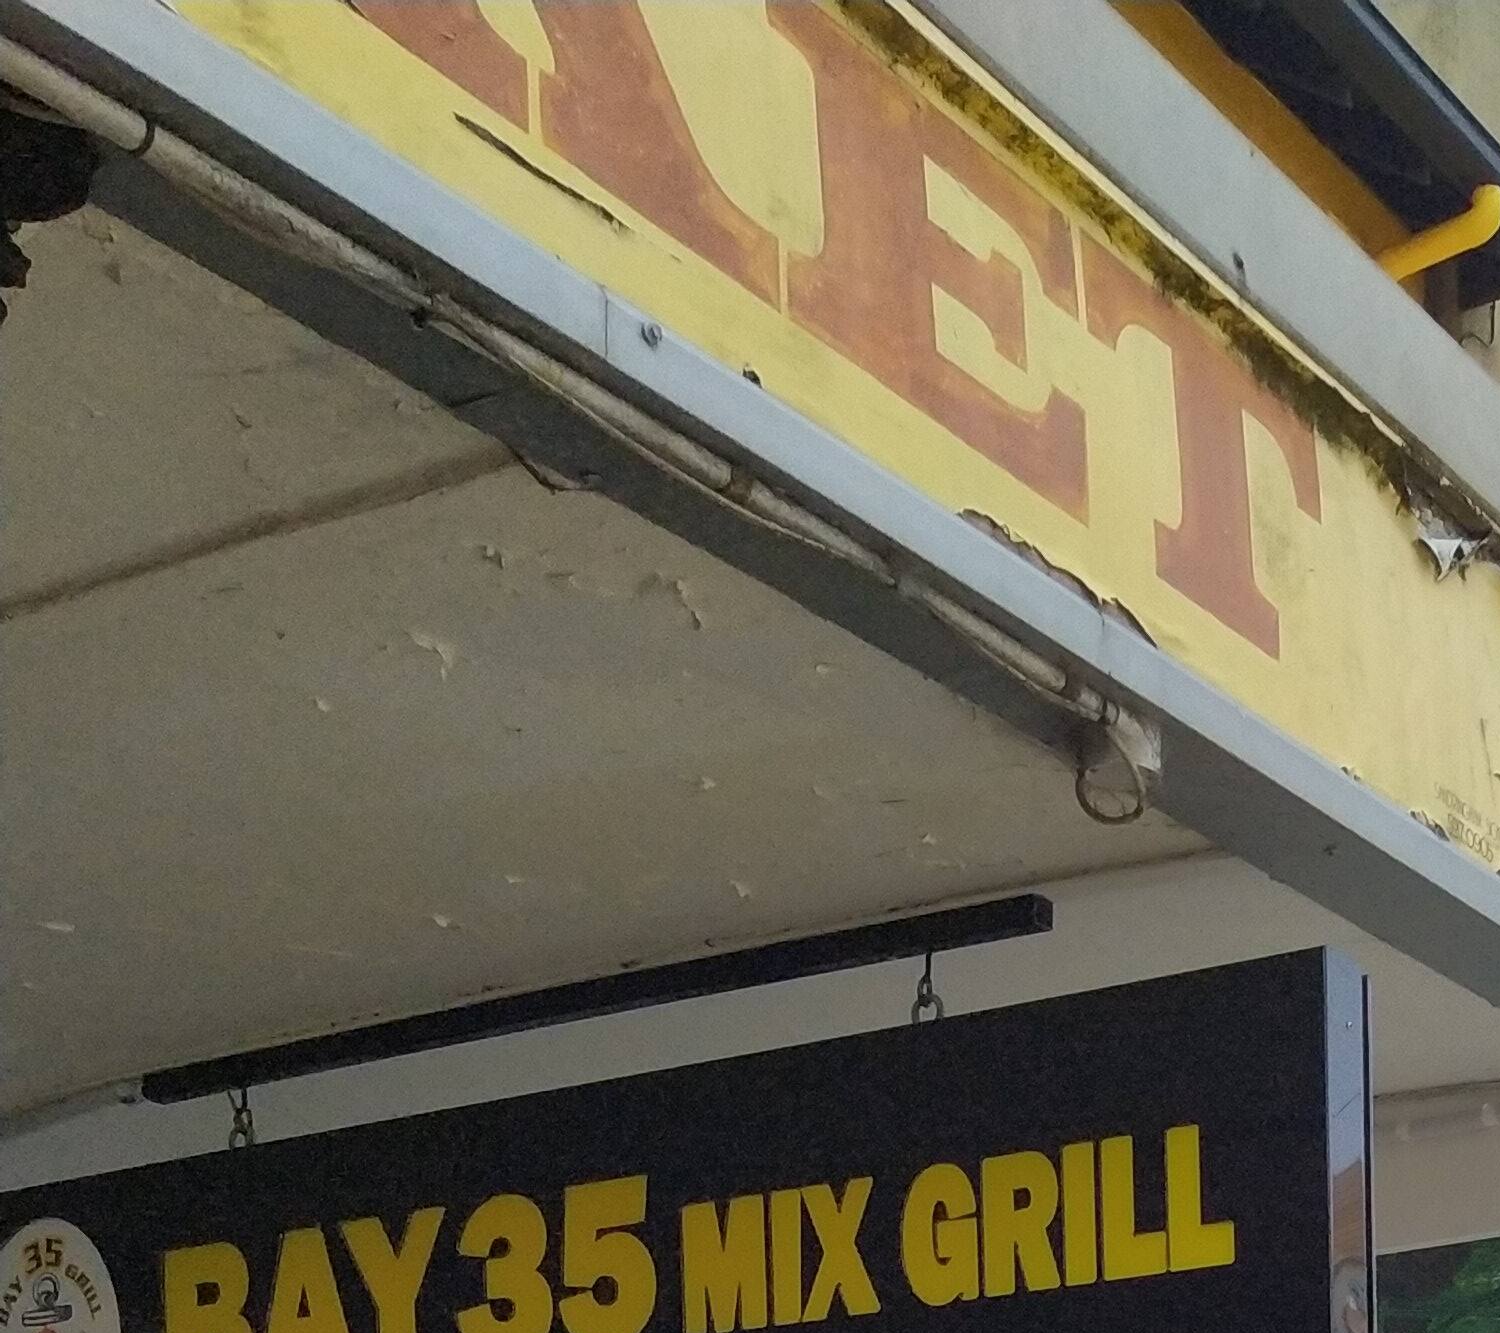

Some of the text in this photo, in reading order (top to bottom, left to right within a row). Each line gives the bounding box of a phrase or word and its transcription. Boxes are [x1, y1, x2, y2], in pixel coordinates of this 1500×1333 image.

[24, 1237, 64, 1275] 35
[64, 1263, 102, 1320] GRILL
[900, 1124, 1236, 1307] GRILL
